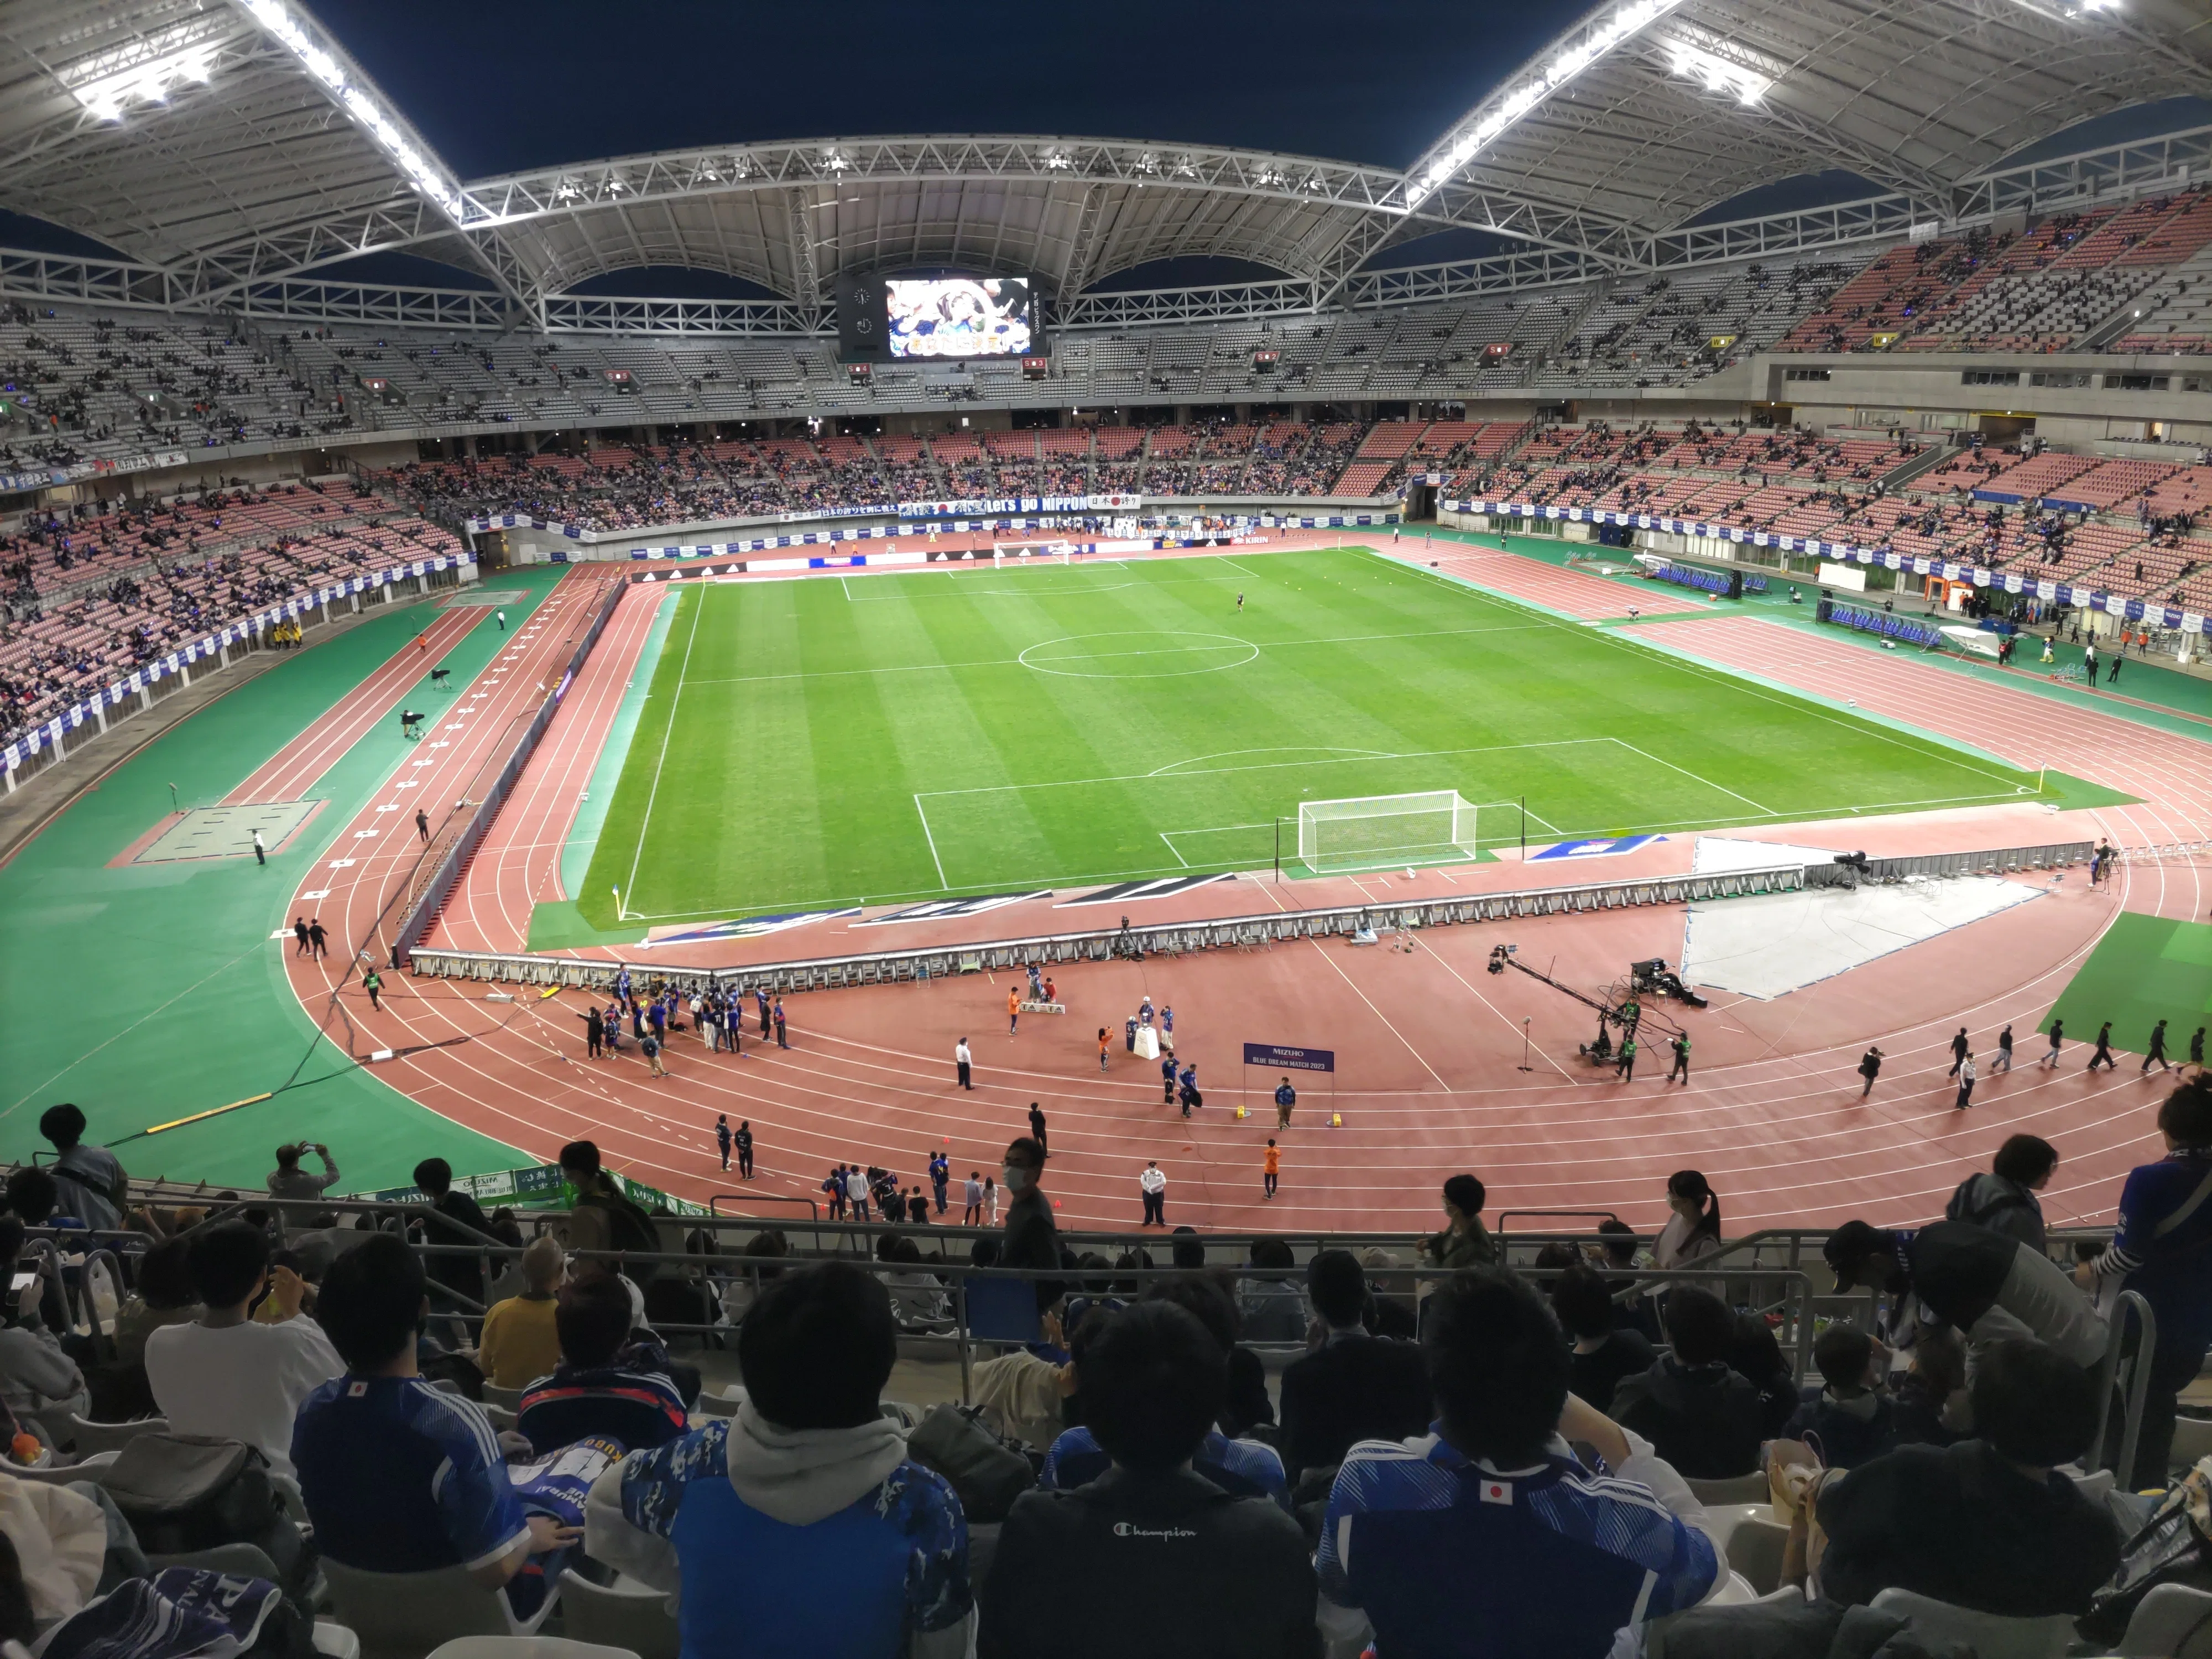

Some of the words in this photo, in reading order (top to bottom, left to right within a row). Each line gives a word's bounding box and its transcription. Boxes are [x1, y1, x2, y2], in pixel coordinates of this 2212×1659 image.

[986, 499, 1016, 513] Let's
[1021, 499, 1038, 512] go
[1042, 497, 1088, 512] NIPPON
[1245, 536, 1269, 545] KIRIN
[1272, 1048, 1304, 1057] MIZUHO
[1289, 1060, 1309, 1068] MATCH
[584, 1438, 622, 1463] KUBO
[1113, 1522, 1197, 1542] Champion
